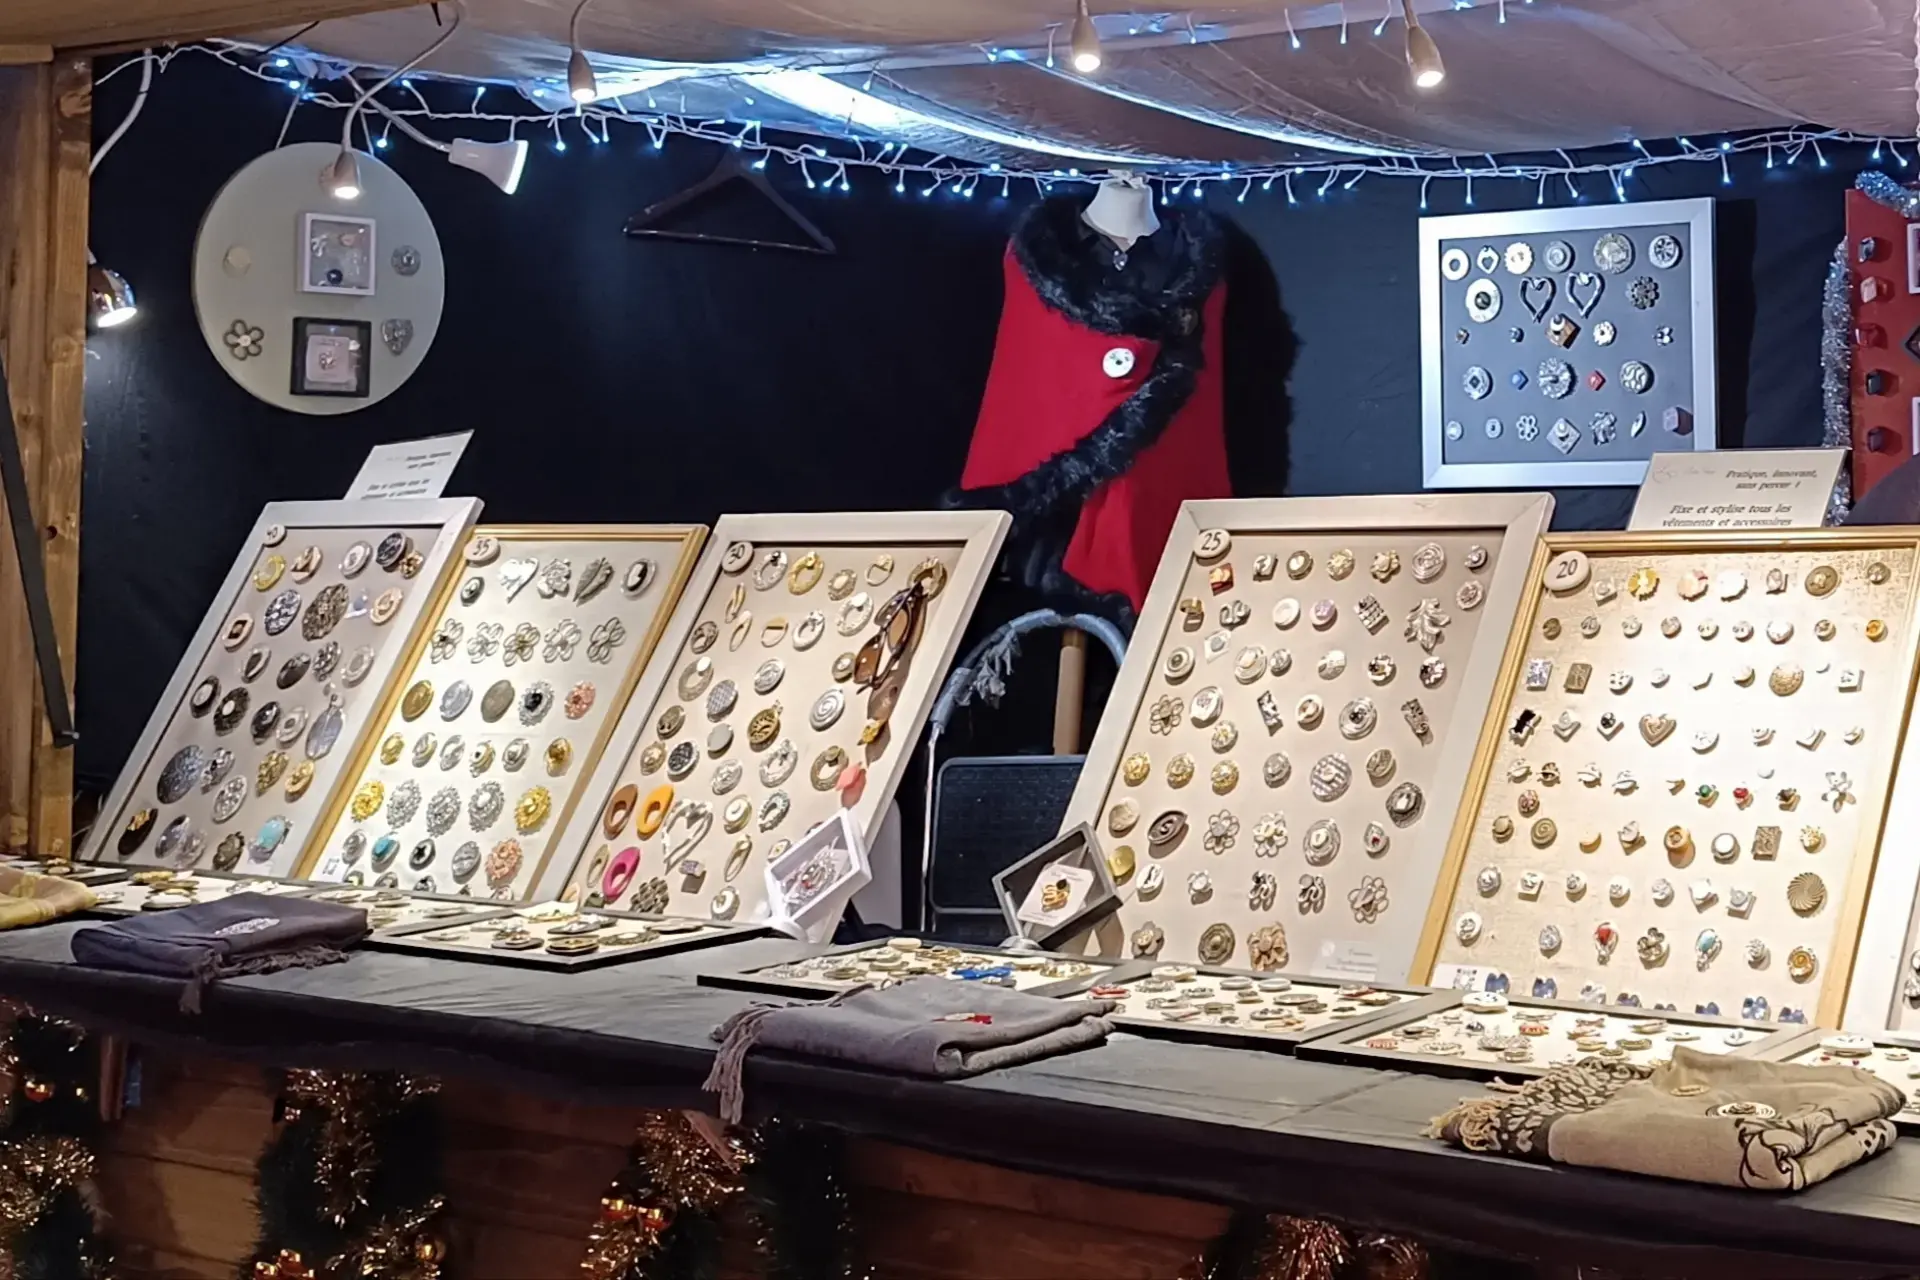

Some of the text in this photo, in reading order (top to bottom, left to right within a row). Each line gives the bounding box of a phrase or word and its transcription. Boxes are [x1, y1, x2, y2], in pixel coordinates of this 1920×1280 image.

[1669, 503, 1793, 516] Fixe et stylise tous les
[1662, 517, 1793, 528] vêtements et accessoires
[473, 538, 491, 557] 35
[1201, 531, 1222, 551] 25
[728, 544, 745, 565] 30
[1556, 558, 1578, 580] 20
